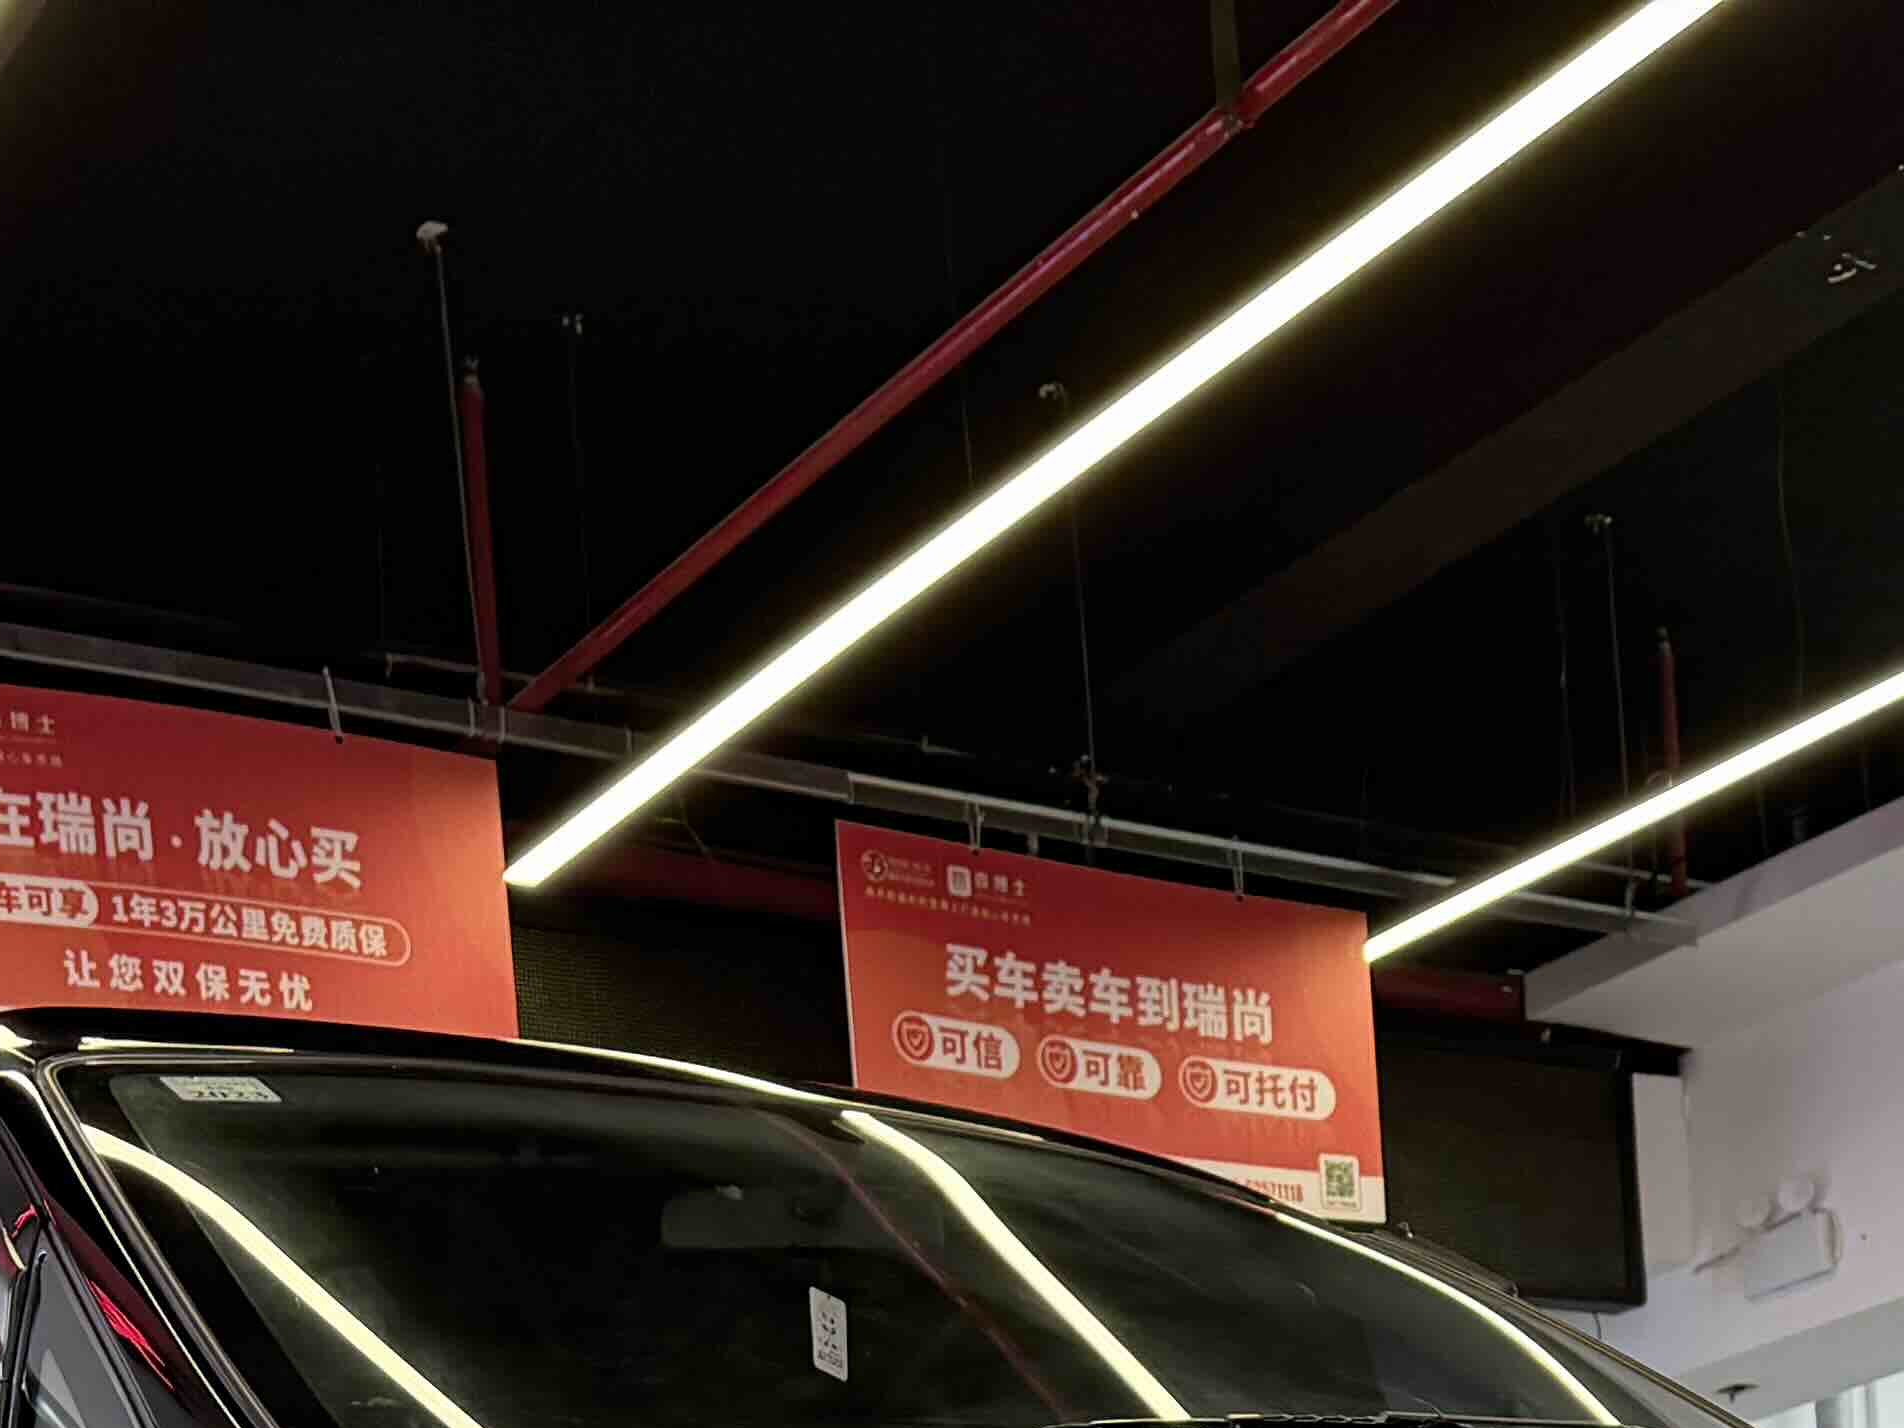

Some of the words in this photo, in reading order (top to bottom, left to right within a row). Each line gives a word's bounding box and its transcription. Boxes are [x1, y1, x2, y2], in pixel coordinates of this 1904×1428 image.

[111, 893, 390, 960] 1年3万公里免费质保
[64, 949, 313, 1012] 让您双保无忧
[944, 942, 1273, 1045] 买车卖车到瑞尚
[940, 1025, 1005, 1071] 可信
[1081, 1049, 1147, 1094] 可靠
[1223, 1073, 1319, 1115] 可托付
